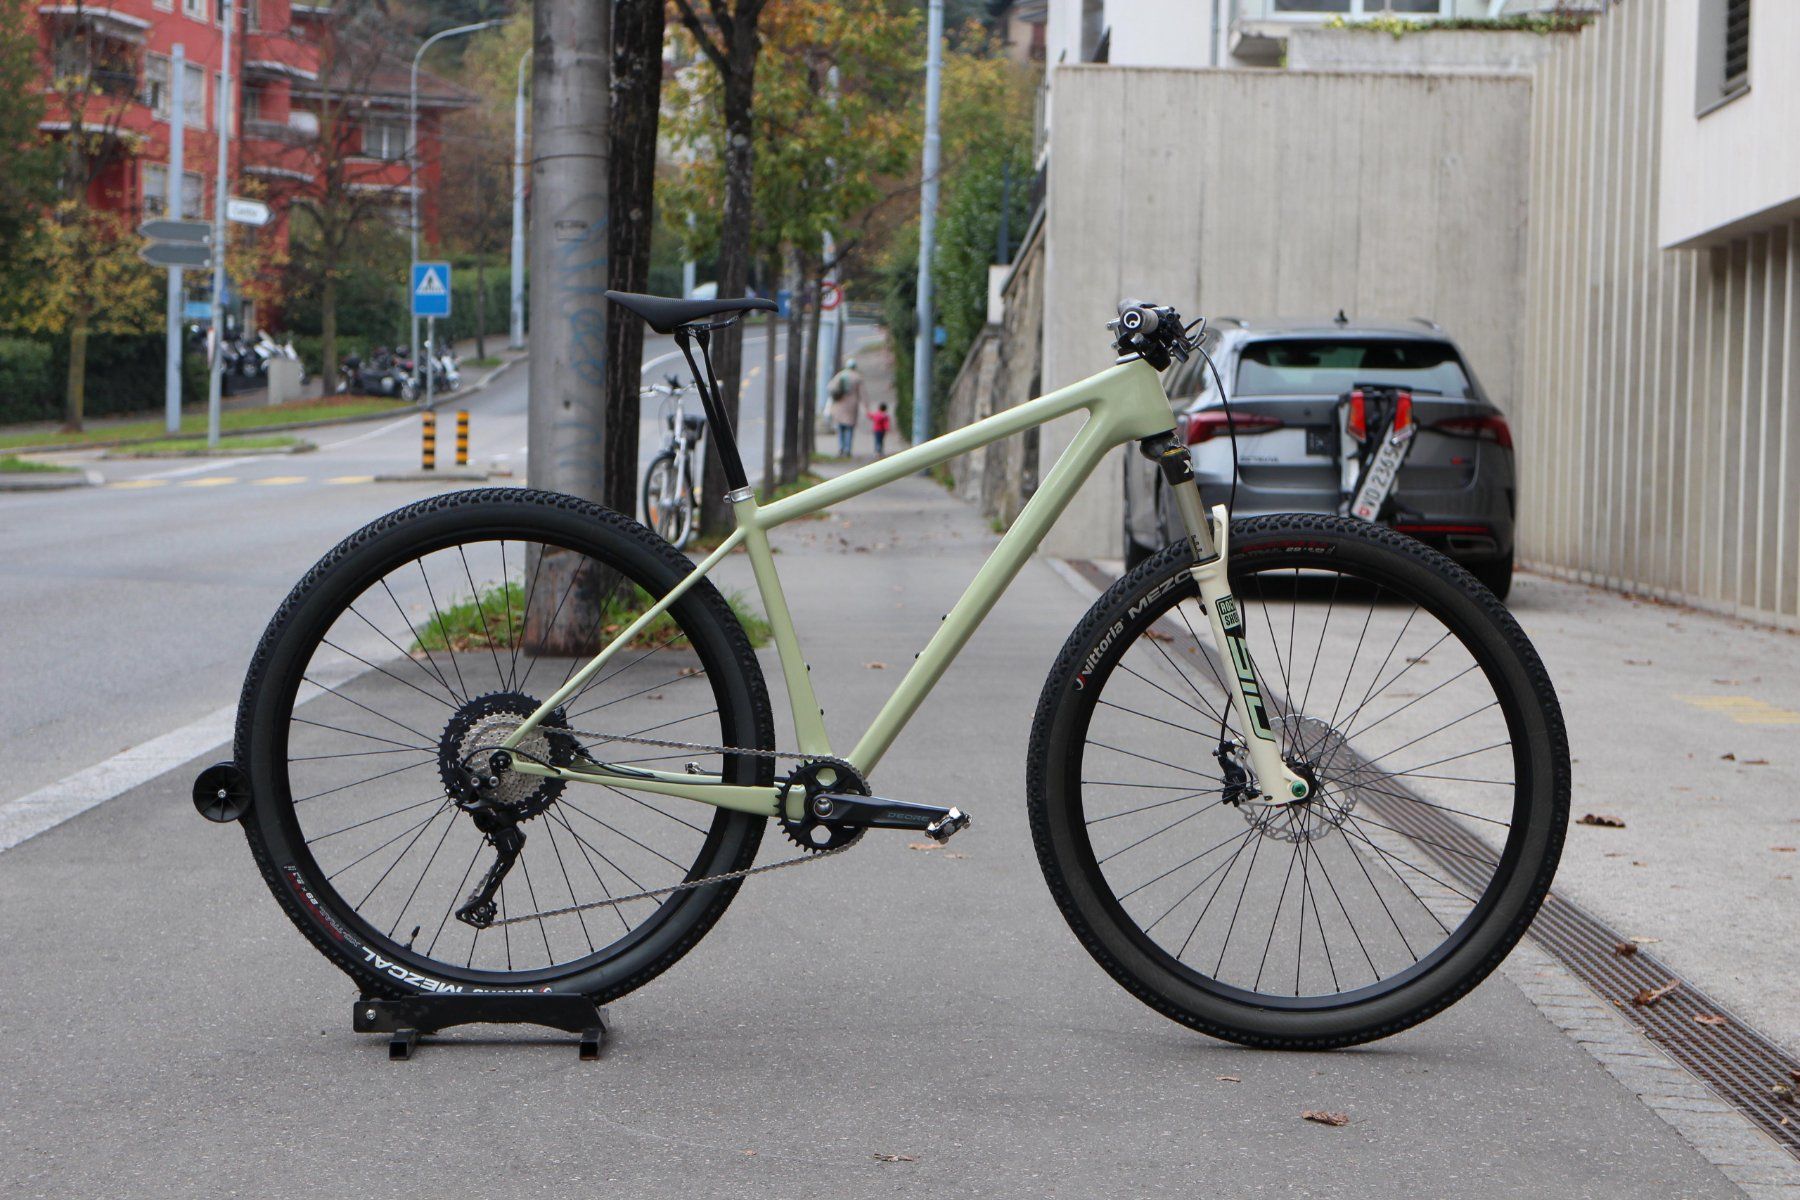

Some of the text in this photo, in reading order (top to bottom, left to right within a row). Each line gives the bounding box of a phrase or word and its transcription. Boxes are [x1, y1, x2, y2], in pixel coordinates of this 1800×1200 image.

[1081, 619, 1125, 676] vittoria
[887, 812, 930, 822] DEORE
[362, 946, 463, 993] MEZCAL
